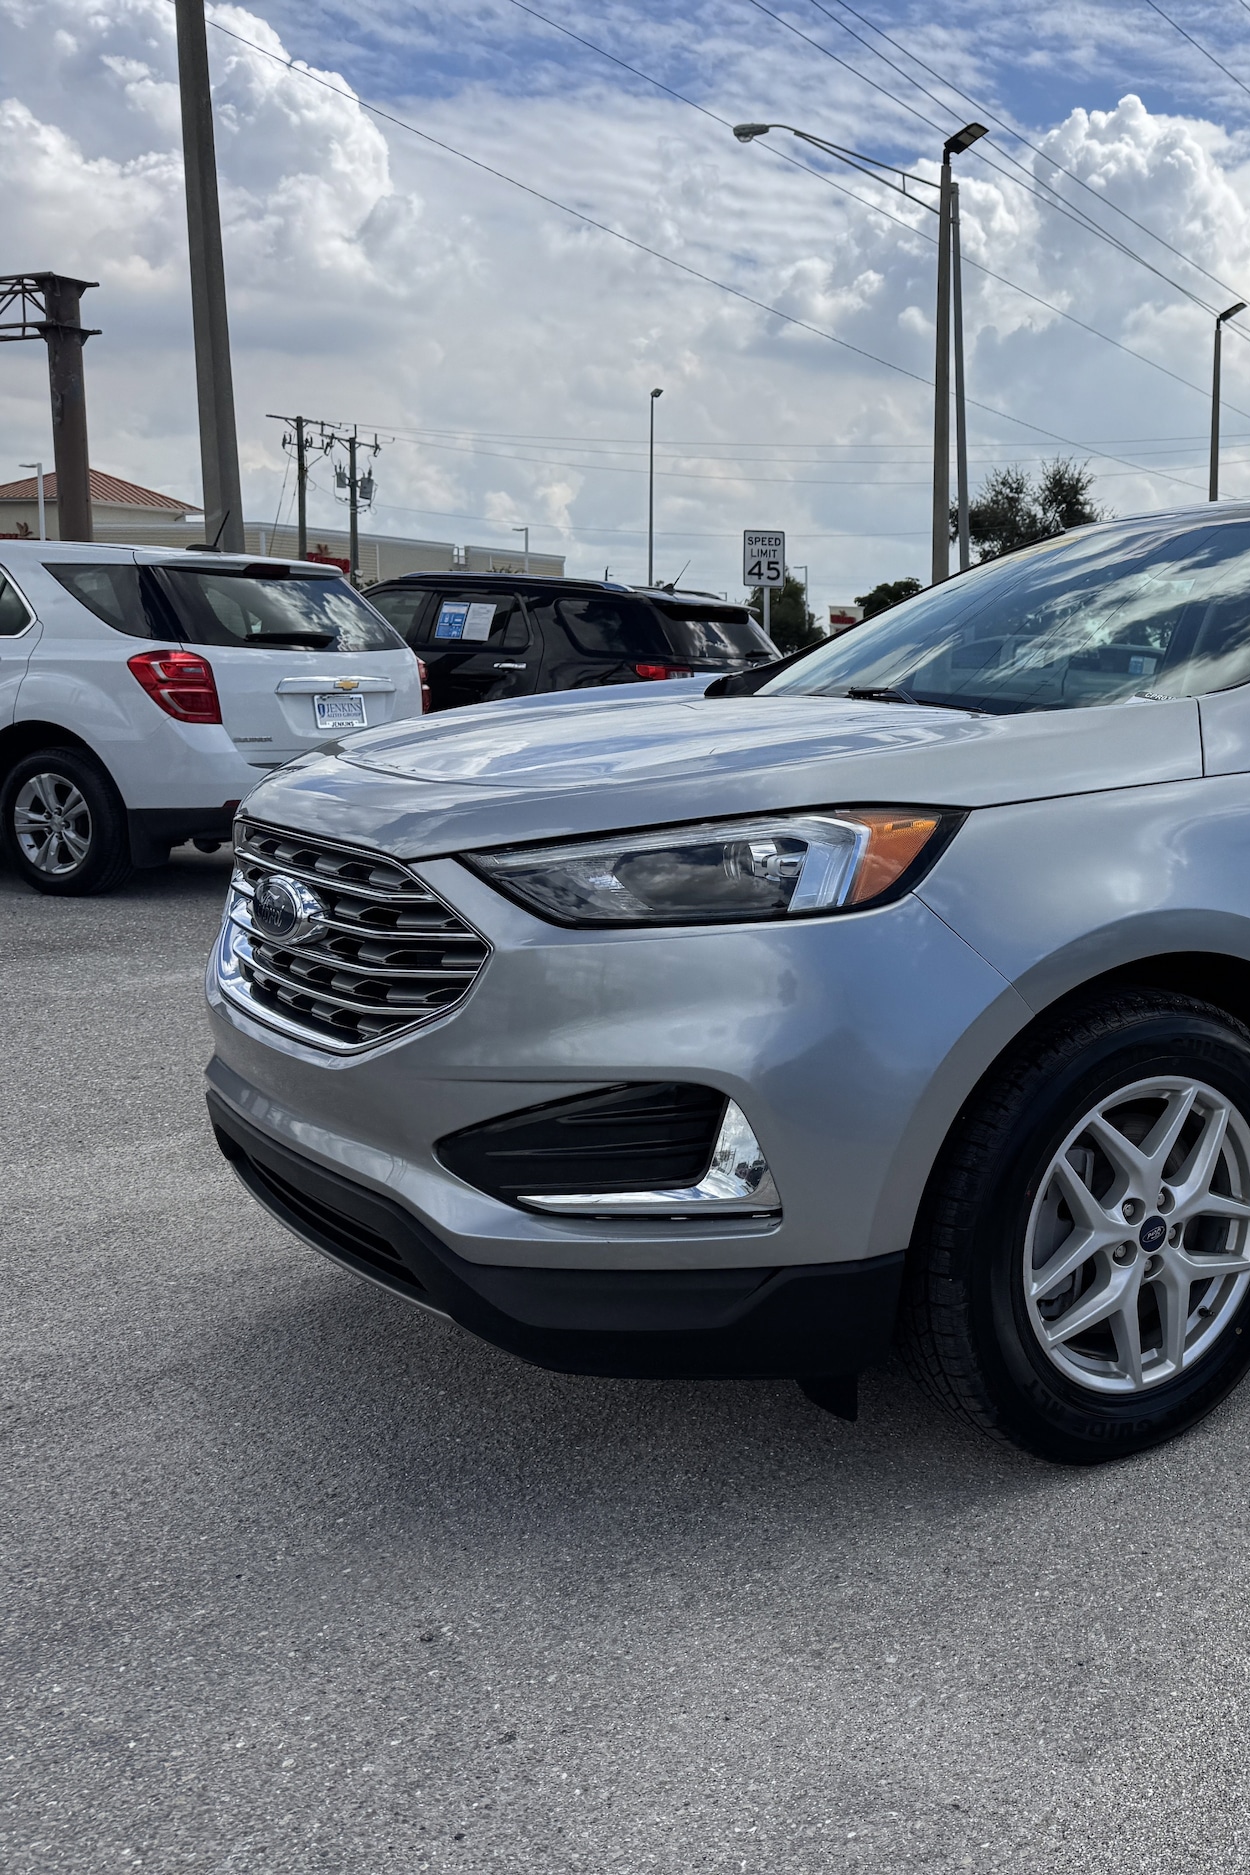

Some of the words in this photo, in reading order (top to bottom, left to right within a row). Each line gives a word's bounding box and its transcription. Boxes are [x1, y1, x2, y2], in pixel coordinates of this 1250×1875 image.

[747, 536, 782, 547] SPEED
[750, 548, 778, 559] LIMIT
[747, 560, 781, 581] 45
[326, 702, 362, 713] JENKINS
